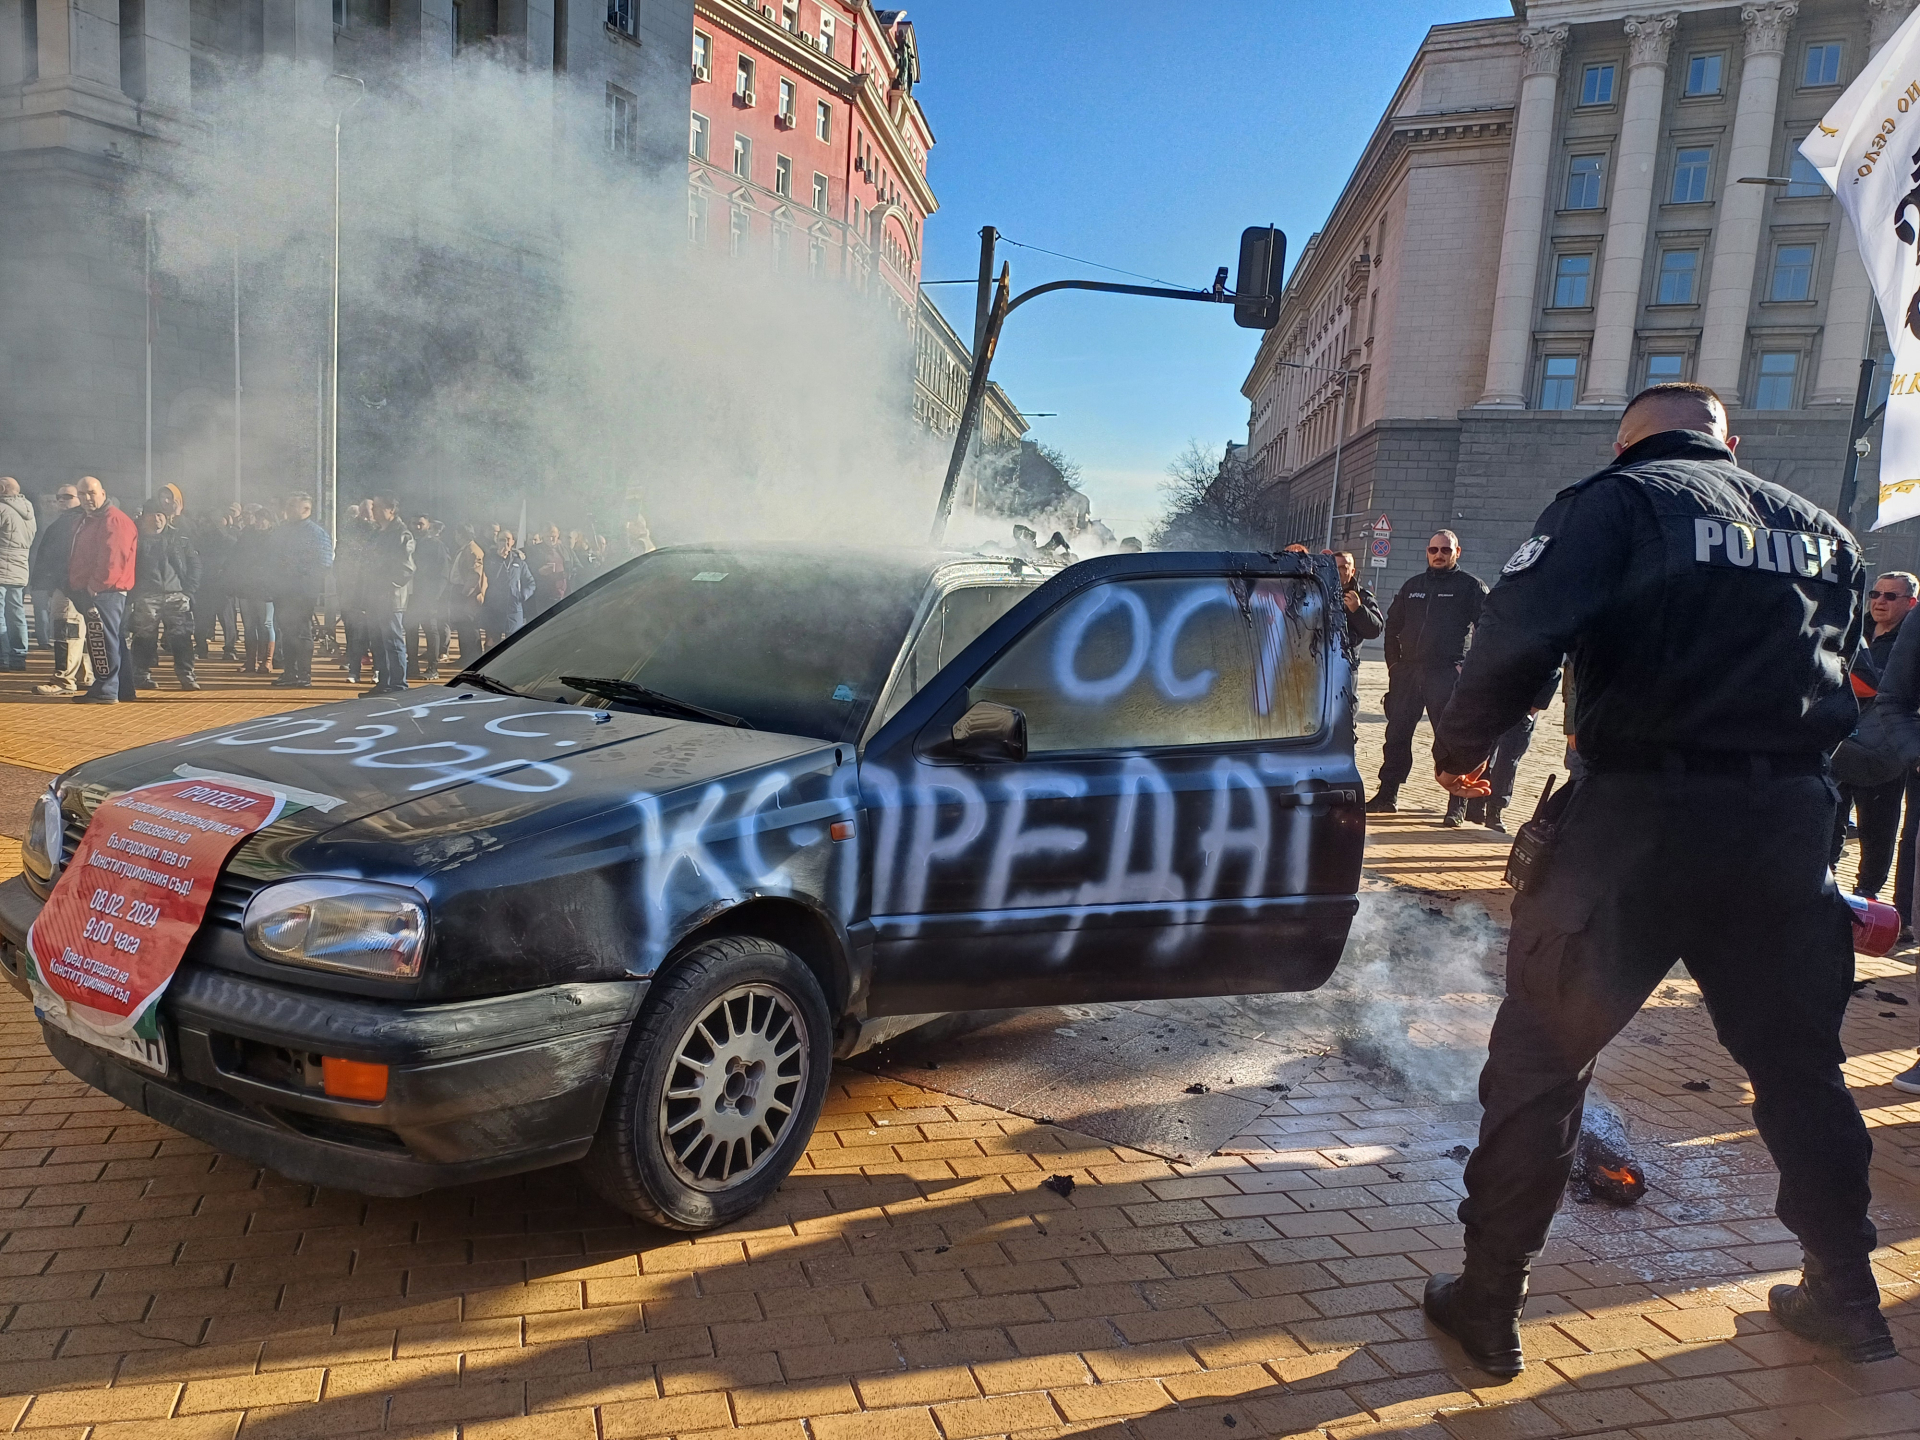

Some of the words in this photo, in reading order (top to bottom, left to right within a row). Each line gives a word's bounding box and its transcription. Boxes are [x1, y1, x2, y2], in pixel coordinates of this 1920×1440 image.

[1694, 518, 1838, 583] POLICE
[87, 621, 110, 675] SABRES
[113, 797, 133, 808] Да
[130, 801, 167, 817] спасим
[158, 809, 229, 833] референдума
[226, 828, 245, 837] за
[172, 785, 260, 812] ПРОТЕСТ!
[106, 832, 160, 860] българския
[158, 849, 178, 866] лев
[177, 855, 192, 869] от
[128, 819, 181, 841] запазване
[175, 832, 192, 845] на
[88, 849, 170, 888] Конституционния
[168, 878, 194, 897] съд!
[89, 888, 125, 918] 08.02.
[126, 900, 160, 928] 2024
[83, 917, 114, 944] 9:00
[113, 931, 141, 955] часа
[49, 957, 115, 996] Конституционния
[114, 988, 131, 1005] съд
[62, 946, 84, 968] Пред
[83, 958, 120, 980] сградата
[118, 970, 130, 984] на
